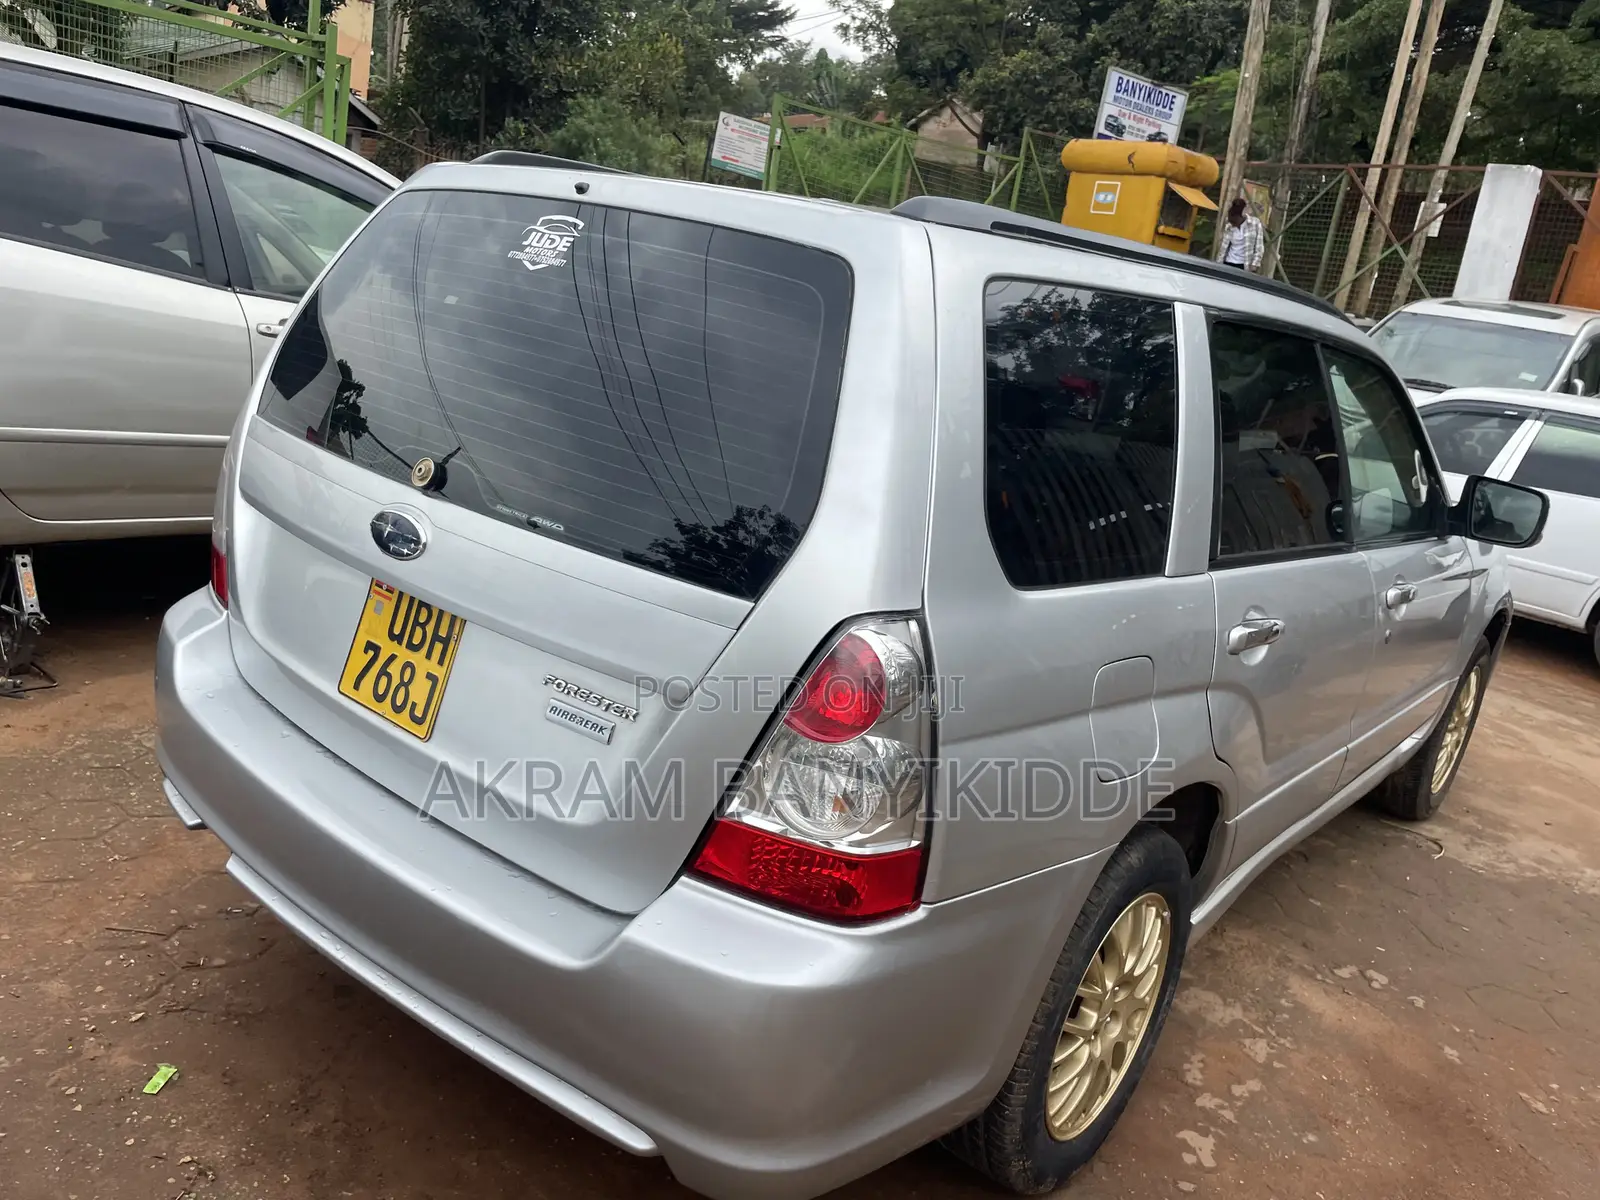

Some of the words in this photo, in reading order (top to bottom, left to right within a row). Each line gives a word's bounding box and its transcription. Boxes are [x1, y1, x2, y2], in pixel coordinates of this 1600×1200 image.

[1113, 95, 1132, 108] MOTOR
[1132, 101, 1154, 115] DEALERS
[1154, 108, 1172, 120] GROUP
[1116, 76, 1176, 111] BANYIKIDDE
[522, 232, 574, 251] JUDE
[523, 246, 559, 258] MOTORS
[387, 590, 458, 667] UBH
[353, 640, 439, 726] 768J
[542, 674, 640, 723] FORESTER
[548, 705, 608, 736] AIRBREAK
